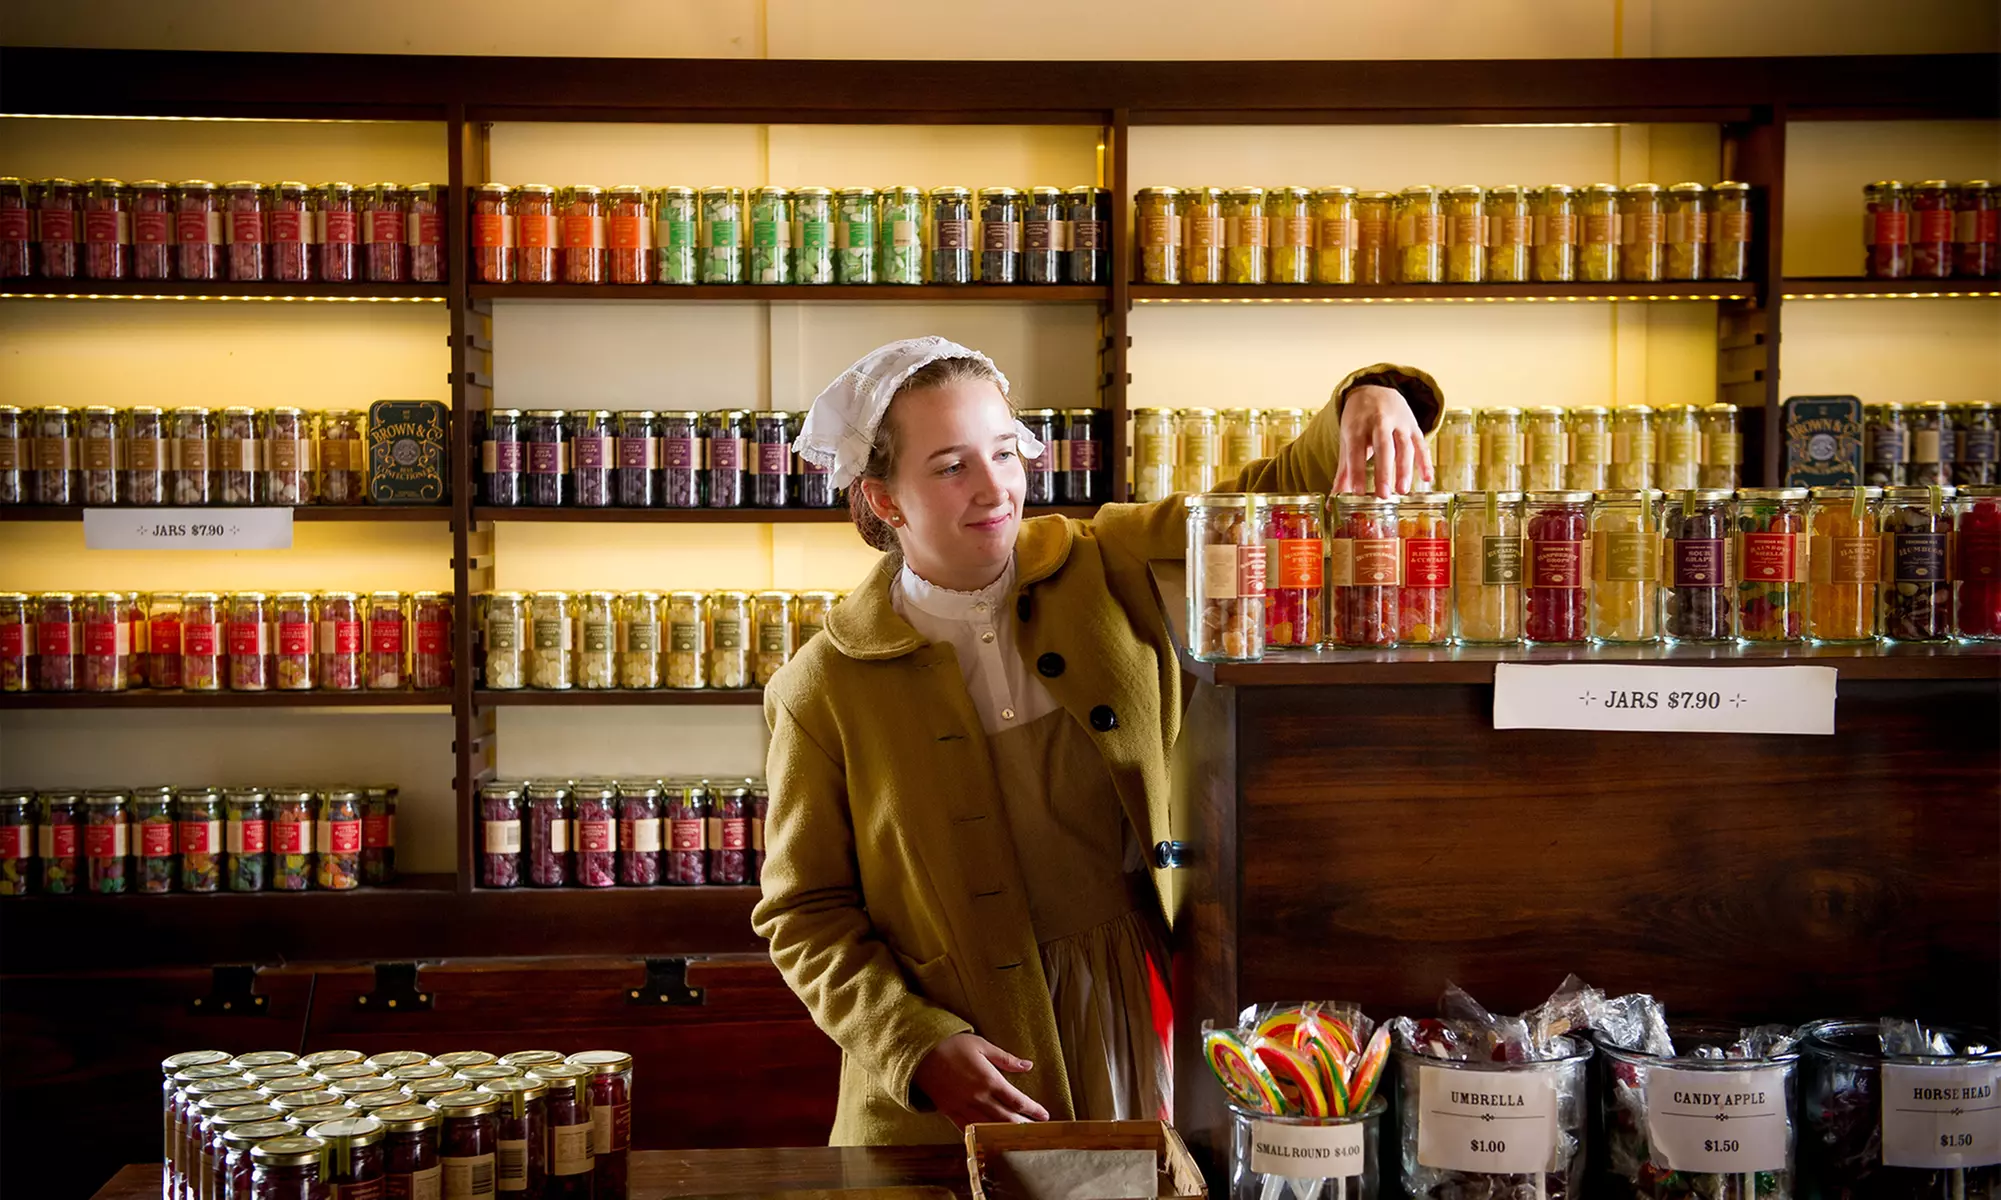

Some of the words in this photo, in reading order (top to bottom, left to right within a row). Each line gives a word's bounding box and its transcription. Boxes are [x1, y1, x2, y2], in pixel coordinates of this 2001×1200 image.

[371, 423, 416, 443] BROWN
[416, 424, 426, 438] &
[152, 524, 186, 537] JARS
[191, 524, 224, 537] $7.90
[1750, 545, 1793, 554] RAINBOW
[1840, 547, 1876, 557] BARLEY
[1899, 545, 1943, 557] HUMBUGS
[1536, 552, 1578, 562] RASPBERRY
[1604, 690, 1659, 709] JARS
[1667, 691, 1721, 710] $7.90
[1451, 1090, 1525, 1107] UMBRELLA
[1673, 1091, 1721, 1106] CANDY
[1723, 1092, 1765, 1106] APPLE
[1913, 1087, 1959, 1101] HORSE
[1961, 1085, 1991, 1100] HEAD
[1470, 1139, 1506, 1153] $1.00
[1704, 1139, 1739, 1153] $1.50
[1940, 1133, 1973, 1147] $1.50
[1256, 1142, 1291, 1158] SMALL
[1291, 1147, 1331, 1159] ROUND
[1334, 1144, 1360, 1158] $4.00
